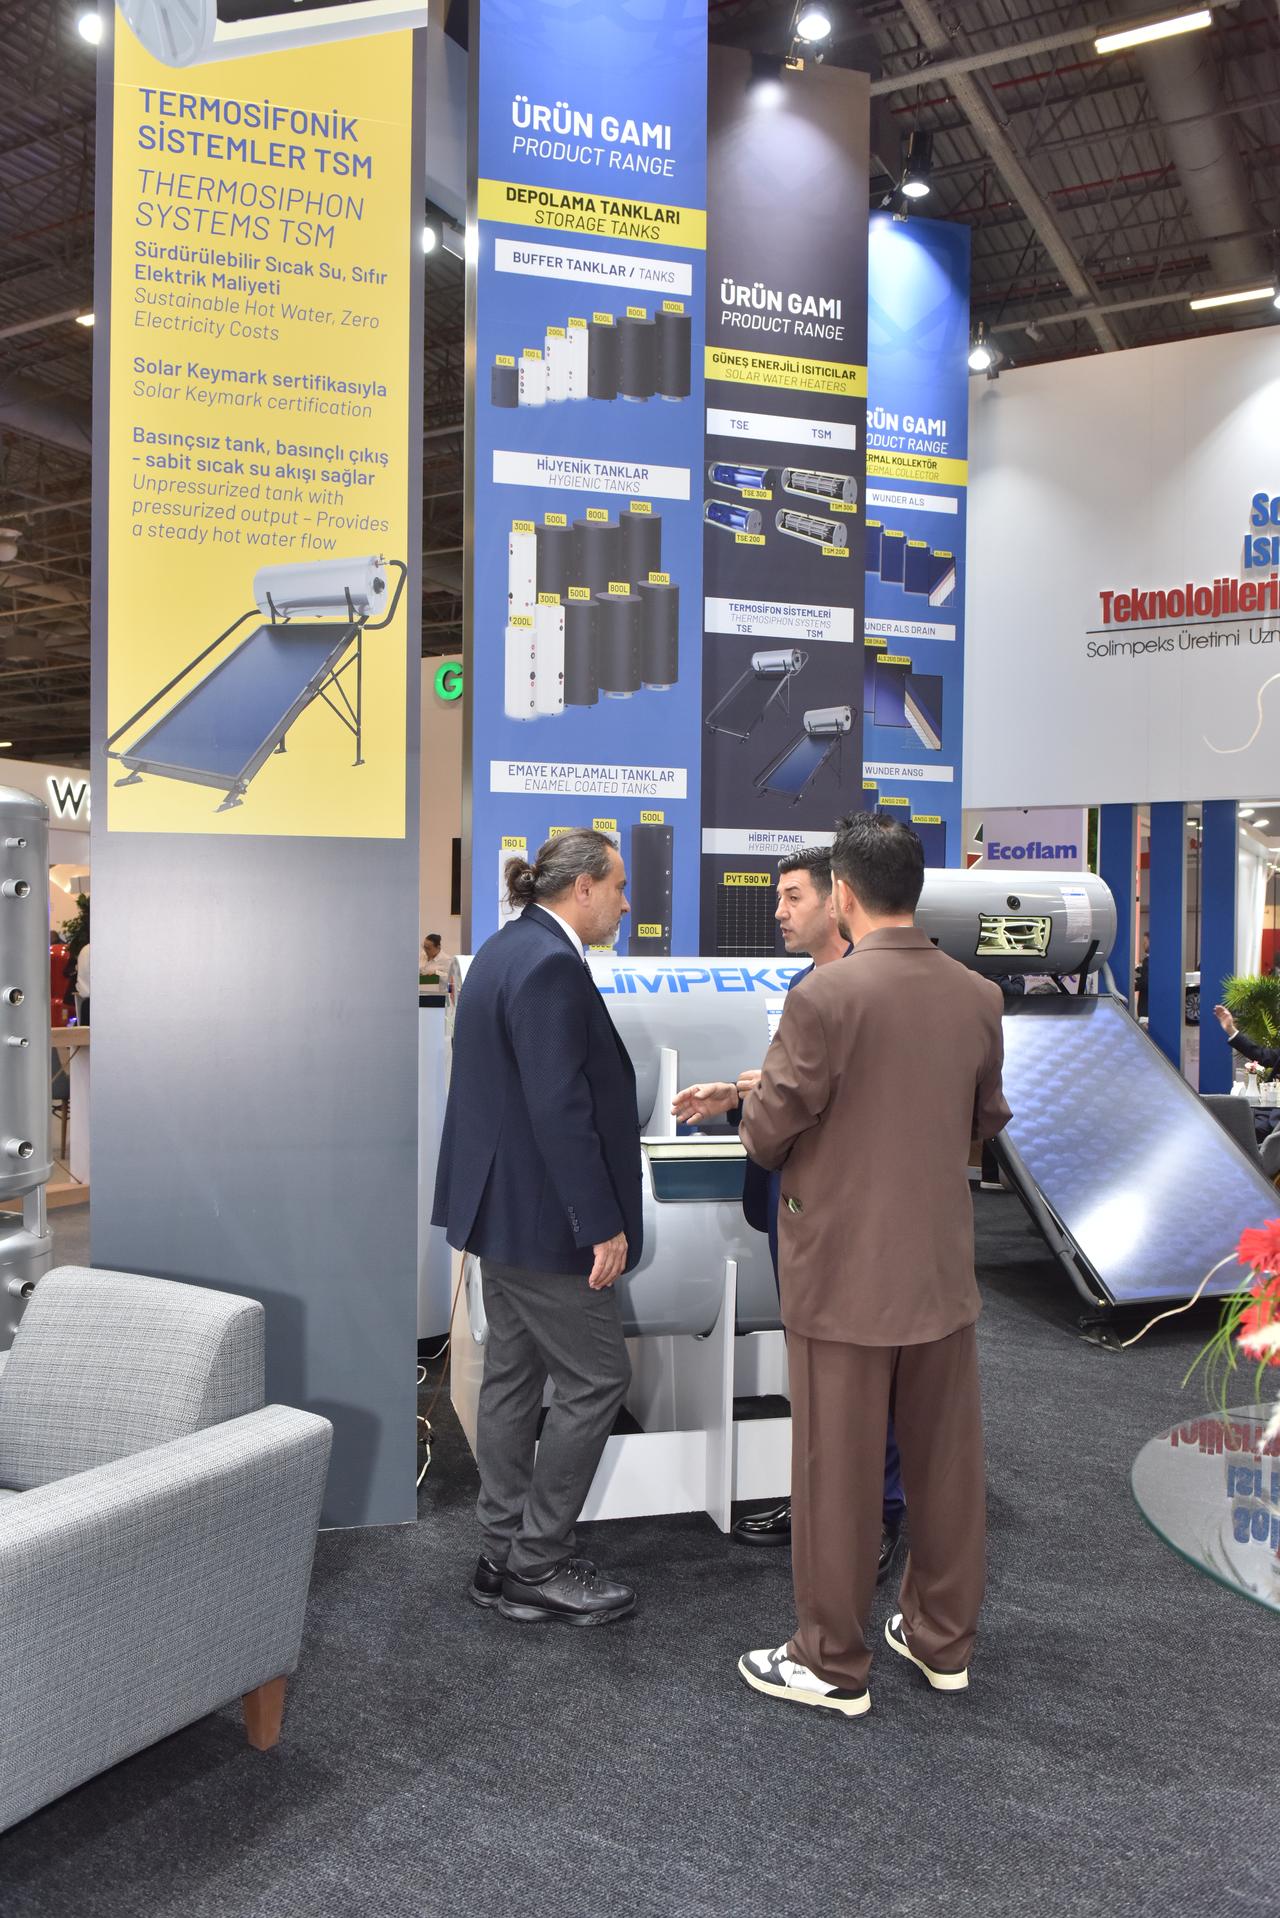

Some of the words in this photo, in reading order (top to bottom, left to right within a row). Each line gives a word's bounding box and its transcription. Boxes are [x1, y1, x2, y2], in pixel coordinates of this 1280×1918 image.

[139, 88, 359, 142] TERMOSİFONİK
[512, 95, 593, 138] ÜRÜN
[601, 116, 671, 150] GAMI
[138, 121, 306, 170] SİSTEMLER
[314, 148, 372, 179] TSM
[513, 136, 605, 166] PRODUCT
[609, 151, 676, 177] RANGE
[138, 168, 364, 221] THERMOSIPHON
[507, 187, 595, 212] DEPOLAMA
[600, 200, 680, 225] TANKLARI
[136, 202, 270, 241] SYSTEMS
[279, 219, 335, 249] TSM
[534, 210, 606, 232] STORAGE
[611, 220, 660, 240] TANKS
[135, 241, 261, 270] Sürdürülebilir
[266, 256, 314, 276] Sıcak
[320, 263, 346, 282] Su,
[352, 267, 387, 285] Sıfır
[513, 251, 563, 268] BUFFER
[567, 258, 626, 276] TANKLAR
[640, 268, 675, 283] TANKS
[135, 264, 206, 287] Elektrik
[212, 272, 281, 296] Maliyeti
[664, 303, 682, 312] 1000L
[721, 278, 782, 311] ÜRÜN
[788, 294, 842, 319] GAMI
[134, 288, 240, 314] Sustainable
[245, 300, 274, 318] Hot
[281, 304, 335, 325] Water,
[340, 310, 380, 329] Zero
[134, 310, 224, 336] Electricity
[229, 320, 279, 340] Costs
[569, 319, 584, 327] 300L
[595, 314, 611, 323] 500L
[721, 311, 791, 333] PRODUCT
[794, 321, 845, 340] RANGE
[549, 328, 563, 337] 200L
[713, 352, 748, 368] GÜNEŞ
[751, 359, 799, 373] ENERJİLİ
[802, 365, 856, 380] ISITICILAR
[133, 357, 182, 377] Solar
[187, 362, 267, 385] Keymark
[272, 374, 387, 399] sertifikasıyla
[725, 369, 760, 381] SOLAR
[763, 373, 797, 386] WATER
[800, 378, 847, 392] HEATERS
[132, 380, 181, 400] Solar
[186, 385, 262, 408] Keymark
[267, 395, 372, 418] certification
[730, 420, 749, 430] TSE
[812, 429, 831, 439] TSM
[903, 415, 946, 437] GAMI
[132, 427, 220, 451] Basınçsız
[225, 436, 271, 455] tank,
[276, 440, 344, 462] basınçlı
[349, 448, 389, 468] çıkış
[908, 438, 949, 454] RANGE
[146, 454, 191, 471] sabit
[197, 457, 244, 475] sıcak
[250, 464, 270, 477] su
[275, 463, 316, 483] akışı
[321, 469, 375, 487] sağlar
[537, 459, 591, 474] HİJYENİK
[594, 464, 649, 480] TANKLAR
[892, 457, 937, 469] KOLLEKTÖR
[895, 468, 940, 480] COLLECTOR
[133, 473, 259, 499] Unpressurized
[266, 483, 303, 502] tank
[308, 491, 344, 505] with
[549, 475, 600, 489] HYGIENIC
[605, 480, 641, 492] TANKS
[632, 503, 650, 512] 1000L
[873, 493, 907, 504] WUNDER
[909, 498, 925, 506] ALS
[132, 500, 235, 520] pressurized
[241, 507, 298, 526] output
[316, 511, 389, 532] Provides
[546, 515, 565, 525] 500L
[588, 510, 606, 519] 800L
[132, 523, 142, 536] a
[148, 522, 208, 545] steady
[213, 527, 241, 544] hot
[246, 531, 296, 548] water
[301, 533, 337, 550] flow
[514, 523, 532, 531] 300L
[650, 574, 668, 583] 1000L
[570, 589, 588, 598] 500L
[610, 584, 628, 593] 800L
[540, 595, 558, 603] 300L
[1100, 573, 1280, 624] Teknolojileri
[729, 603, 781, 614] TERMOSİFON
[784, 607, 831, 618] SİSTEMLERİ
[513, 617, 531, 625] 200L
[731, 614, 793, 626] THERMOSIPHON
[795, 619, 831, 629] SYSTEMS
[894, 625, 909, 633] ALS
[911, 626, 935, 635] DRAIN
[807, 630, 823, 638] TSM
[1087, 636, 1174, 657] Solimpeks
[1179, 630, 1239, 650] Üretimi
[508, 765, 547, 777] EMAYE
[551, 767, 617, 780] KAPLAMALI
[622, 769, 674, 781] TANKLAR
[865, 766, 900, 776] WUNDER
[902, 768, 923, 776] ANSG
[525, 779, 571, 791] ENAMEL
[574, 781, 618, 793] COATED
[622, 783, 657, 795] TANKS
[594, 820, 615, 830] 300L
[504, 839, 517, 847] 160
[749, 832, 776, 842] HİBRİT
[778, 835, 805, 843] PANEL
[749, 843, 778, 851] HYBRID
[987, 842, 1077, 860] Ecoflam
